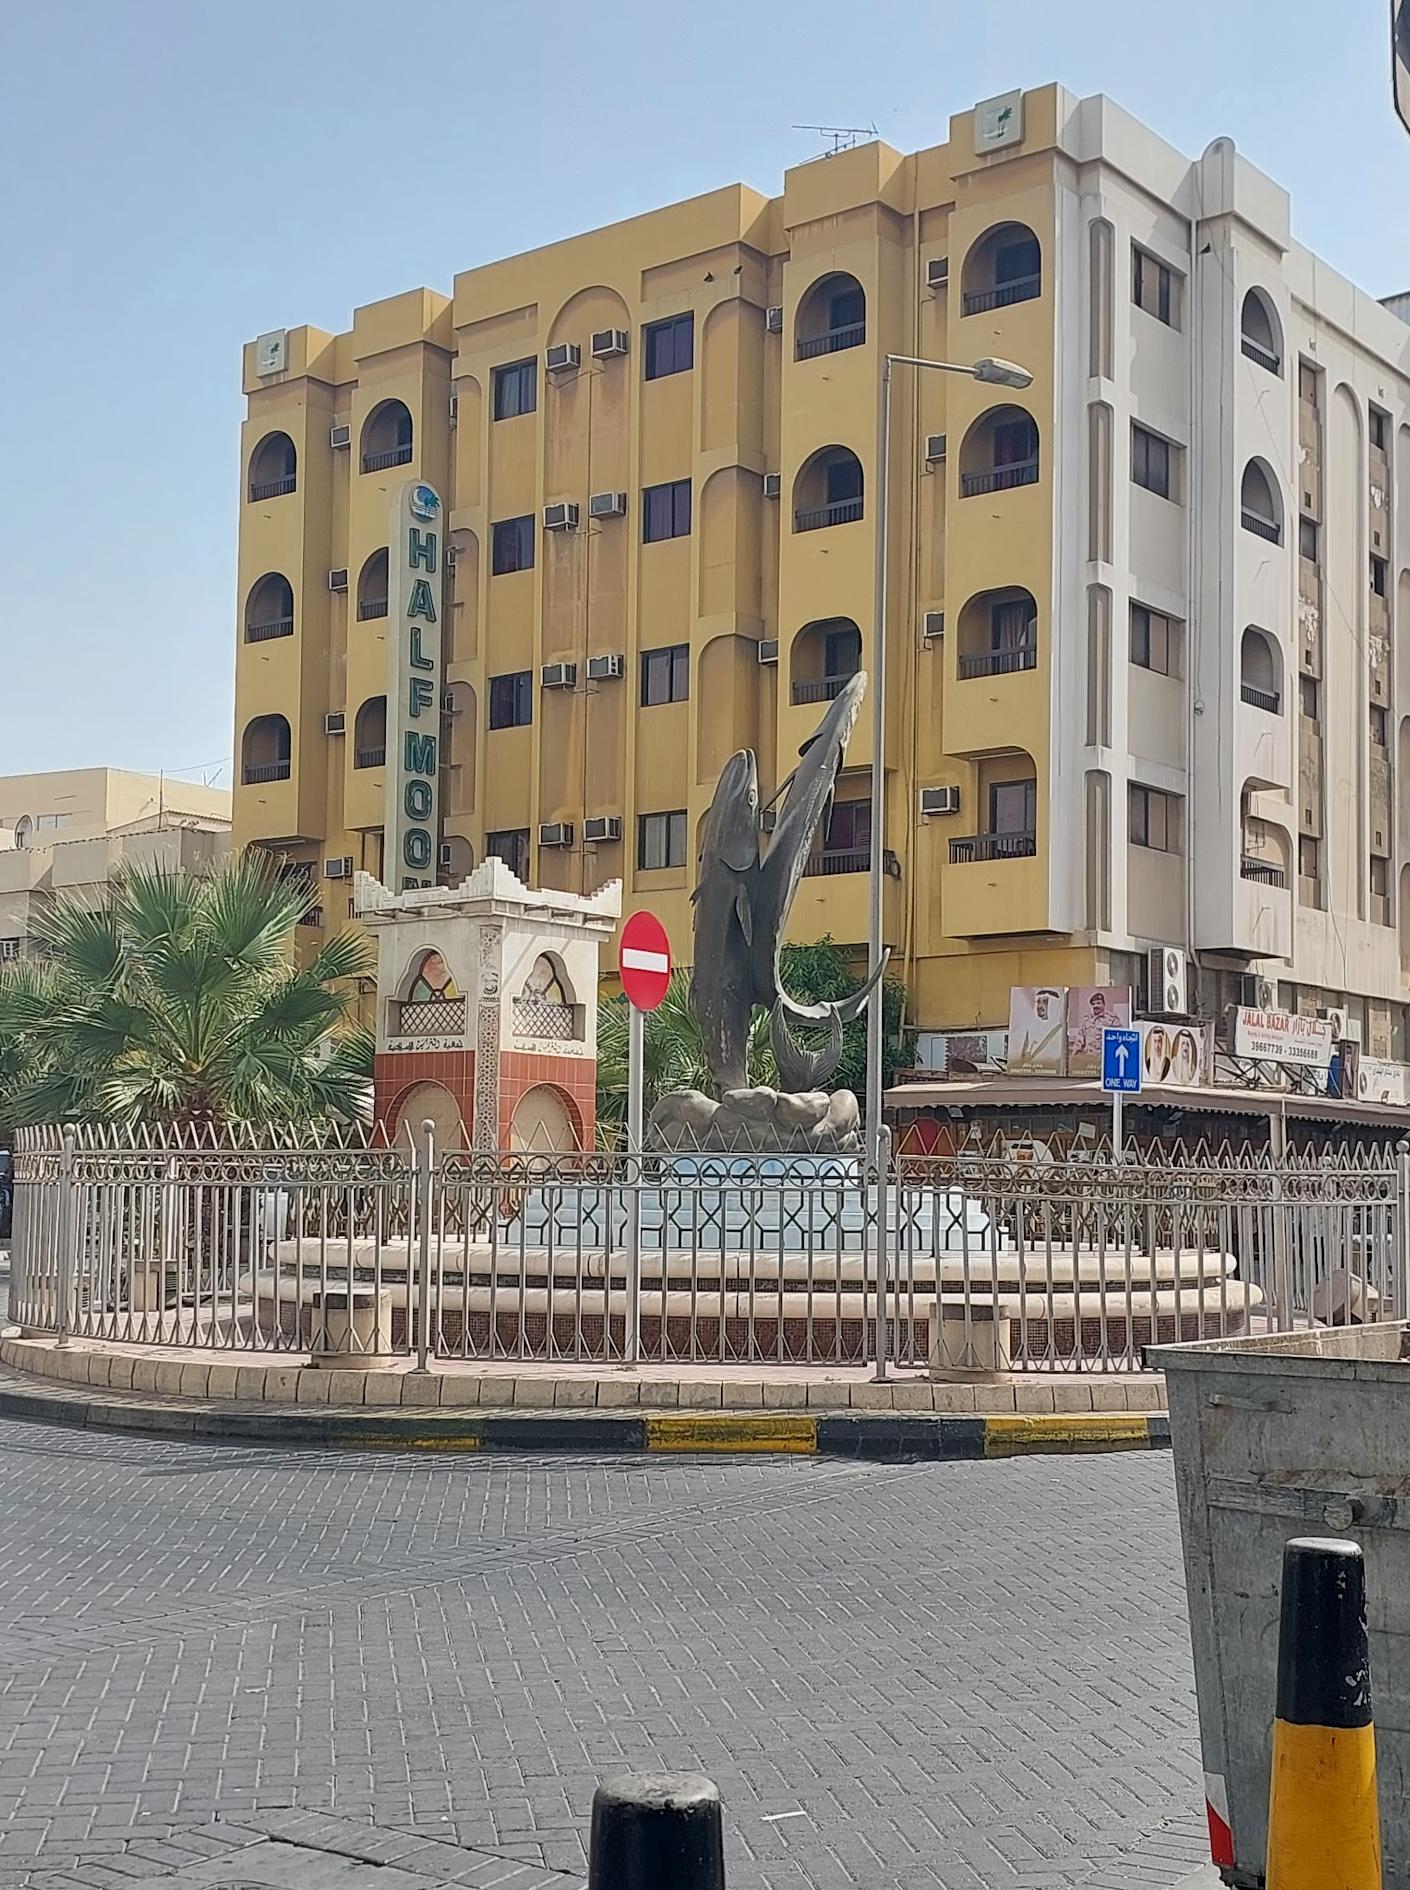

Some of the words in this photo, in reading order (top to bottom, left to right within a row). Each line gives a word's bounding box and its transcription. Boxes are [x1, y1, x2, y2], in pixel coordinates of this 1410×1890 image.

[406, 527, 437, 718] HALF
[1242, 1011, 1265, 1028] JALAL
[1267, 1015, 1290, 1032] BAZAR
[1106, 1032, 1122, 1043] واحد
[1105, 1077, 1121, 1088] ONE
[1122, 1078, 1138, 1088] WAY
